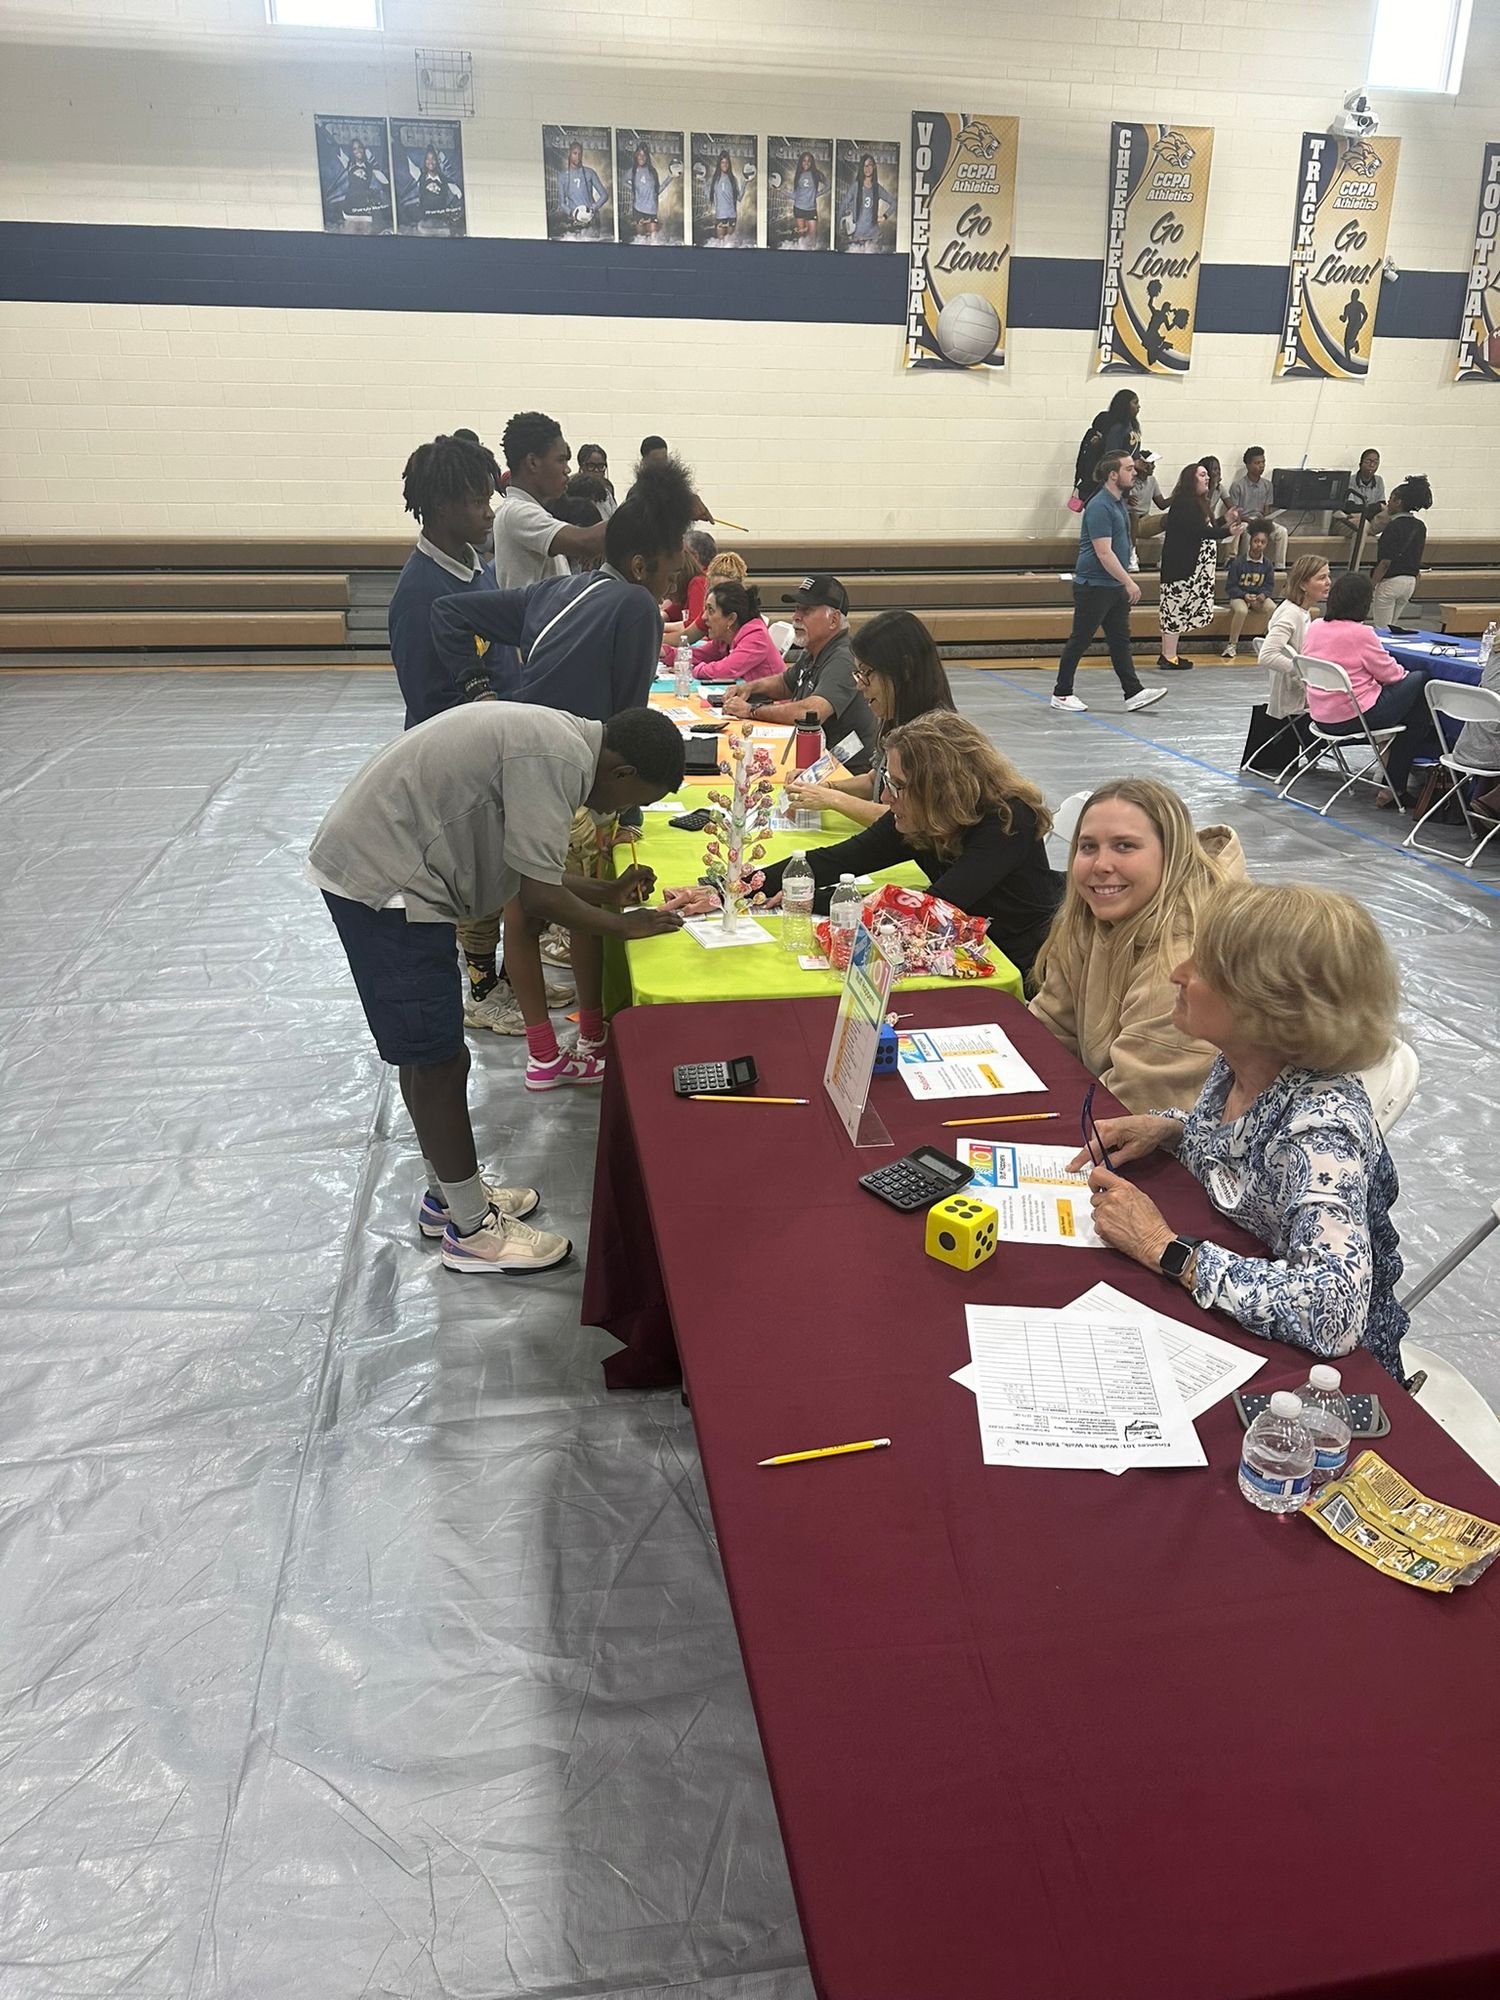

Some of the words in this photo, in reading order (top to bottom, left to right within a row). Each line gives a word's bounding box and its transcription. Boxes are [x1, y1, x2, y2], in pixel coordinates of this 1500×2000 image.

[950, 179, 1000, 194] Athletics
[956, 163, 998, 180] CCPA
[1152, 172, 1191, 189] CCPA
[863, 196, 871, 208] 3
[1146, 188, 1194, 203] Athletics
[1297, 138, 1326, 247] TRACK
[1332, 197, 1378, 211] Athletics
[1338, 180, 1377, 198] CCPA
[955, 203, 993, 239] Go
[1149, 211, 1185, 245] Go
[1334, 218, 1368, 253] Go
[908, 121, 935, 360] VOLLEYBALL
[1100, 128, 1132, 364] CHEERLEADING
[1292, 248, 1315, 263] and
[934, 241, 1011, 274] Lions!
[1127, 247, 1200, 280] Lions!
[1310, 255, 1383, 287] Lions!
[1460, 155, 1500, 368] FOOTBALL
[1283, 265, 1308, 367] FIELD
[971, 1143, 994, 1168] 101
